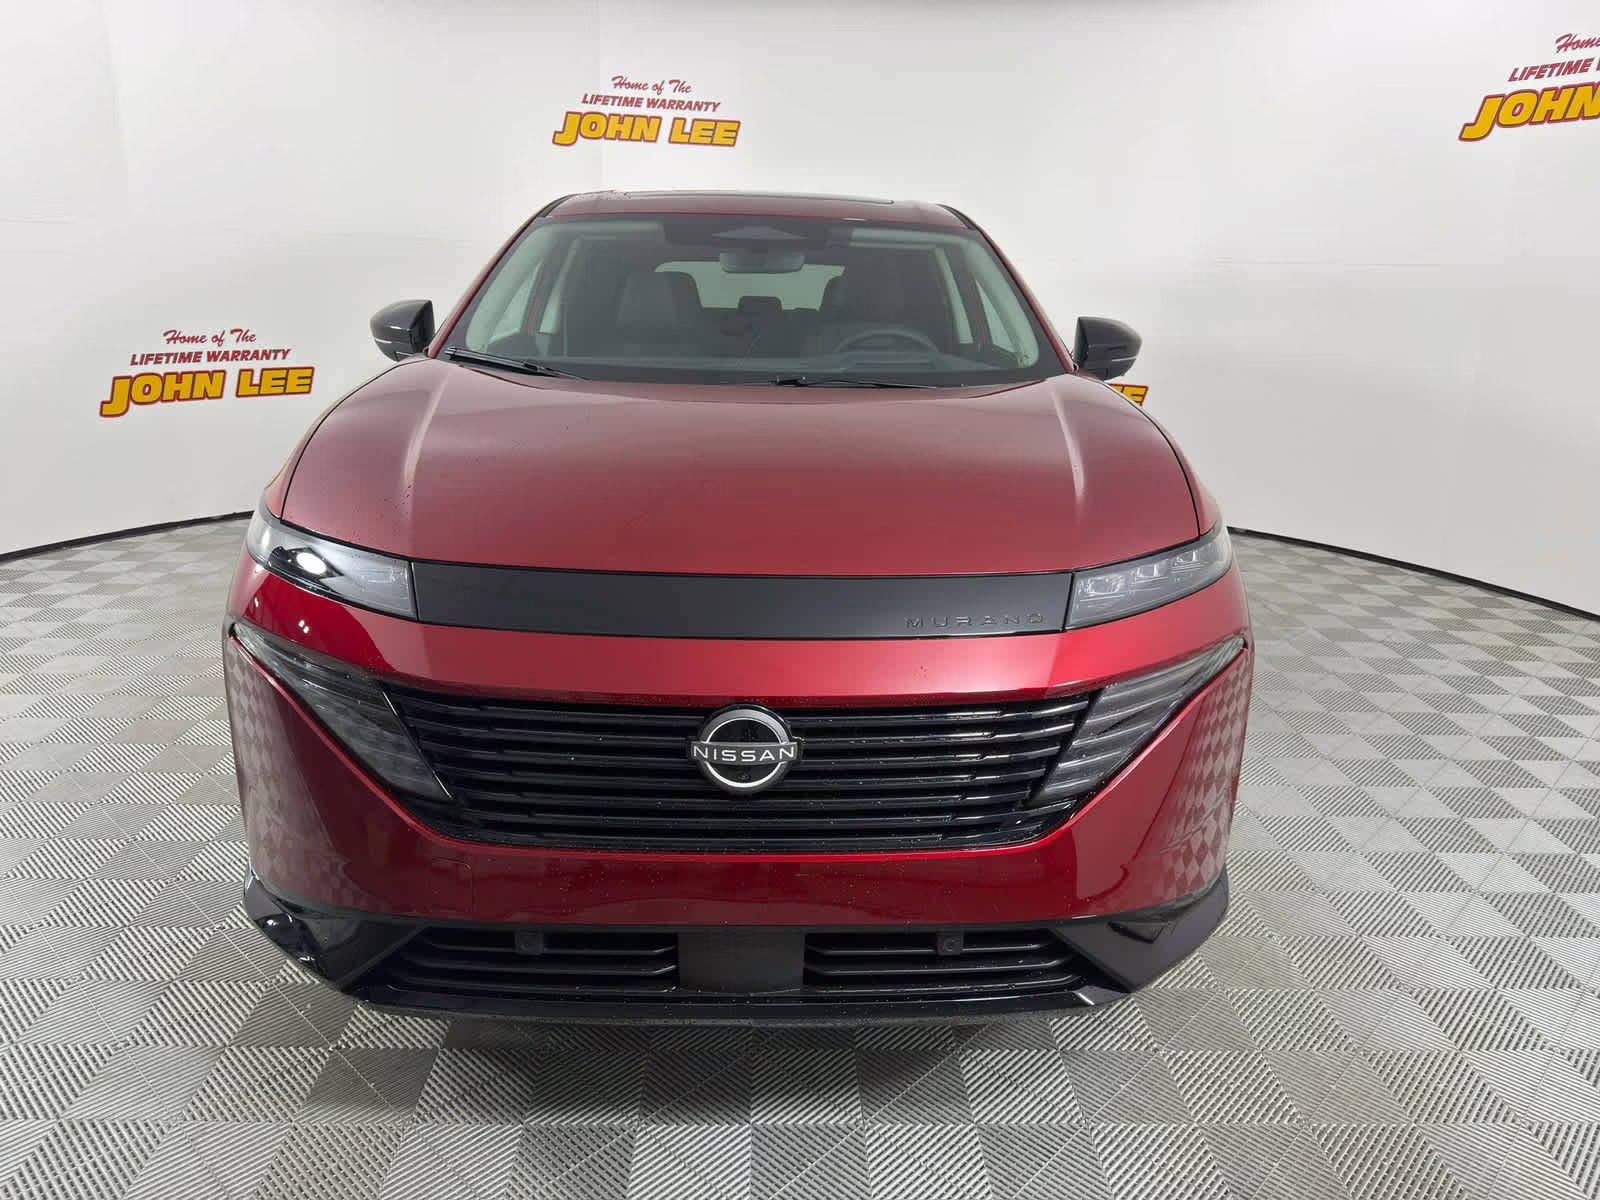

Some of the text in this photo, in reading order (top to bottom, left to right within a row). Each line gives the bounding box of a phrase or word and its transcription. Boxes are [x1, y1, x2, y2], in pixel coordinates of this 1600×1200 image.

[1507, 57, 1595, 82] LIFETIME
[611, 75, 692, 95] Home of The
[581, 94, 721, 113] LIFETIME WARRANTY
[552, 111, 741, 147] JOHN LEE
[163, 328, 257, 346] Home of The
[130, 348, 291, 366] LIFETIME WARRANTY
[99, 366, 315, 417] JOHN LEE
[904, 612, 1044, 629] MURANO
[693, 745, 795, 762] NISSAN
